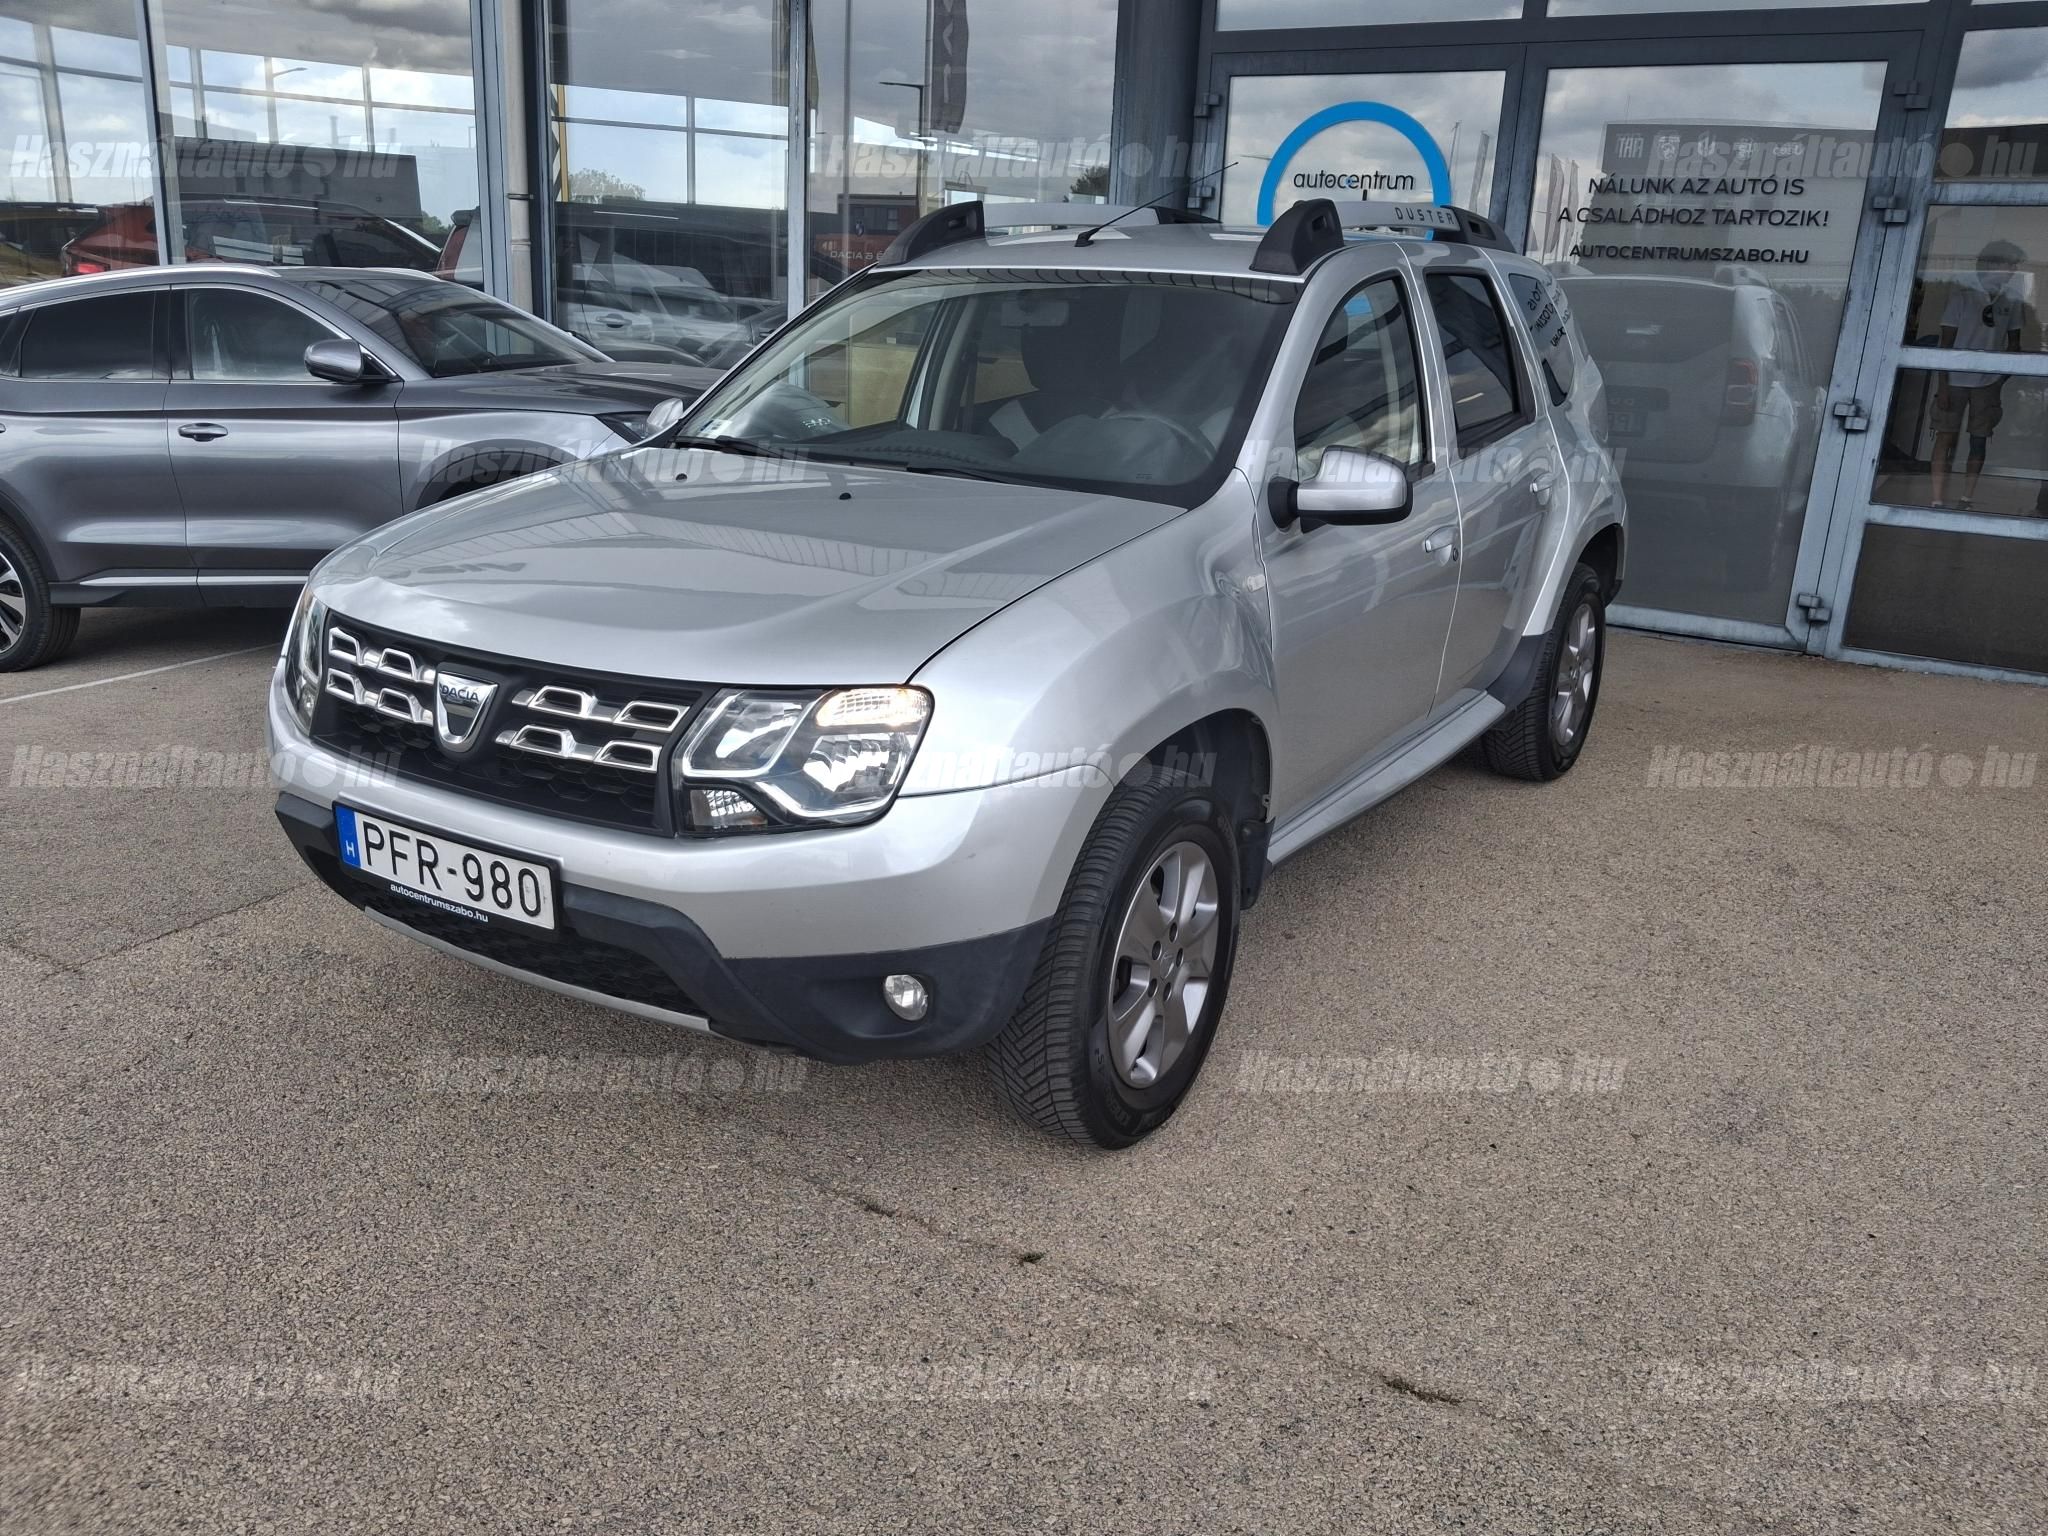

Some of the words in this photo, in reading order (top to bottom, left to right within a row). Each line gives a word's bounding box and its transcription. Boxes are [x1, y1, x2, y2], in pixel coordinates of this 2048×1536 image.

[1293, 170, 1415, 190] autocentrum
[1588, 173, 1675, 195] NÁLUNK
[1680, 178, 1709, 194] AZ
[1714, 174, 1778, 195] AUTÓ
[1783, 178, 1805, 196] IS
[1394, 206, 1455, 225] DUSTER
[1557, 207, 1572, 222] A
[1576, 204, 1706, 226] CSALÁDHOZ
[1711, 209, 1829, 227] TARTOZIK!
[1569, 244, 1809, 264] AUTOCENTRUMSZABO.HU
[442, 685, 479, 702] DACIA
[345, 840, 356, 858] H
[362, 820, 542, 918] PFR-980
[390, 882, 489, 923] autocentrumszabo.hu
